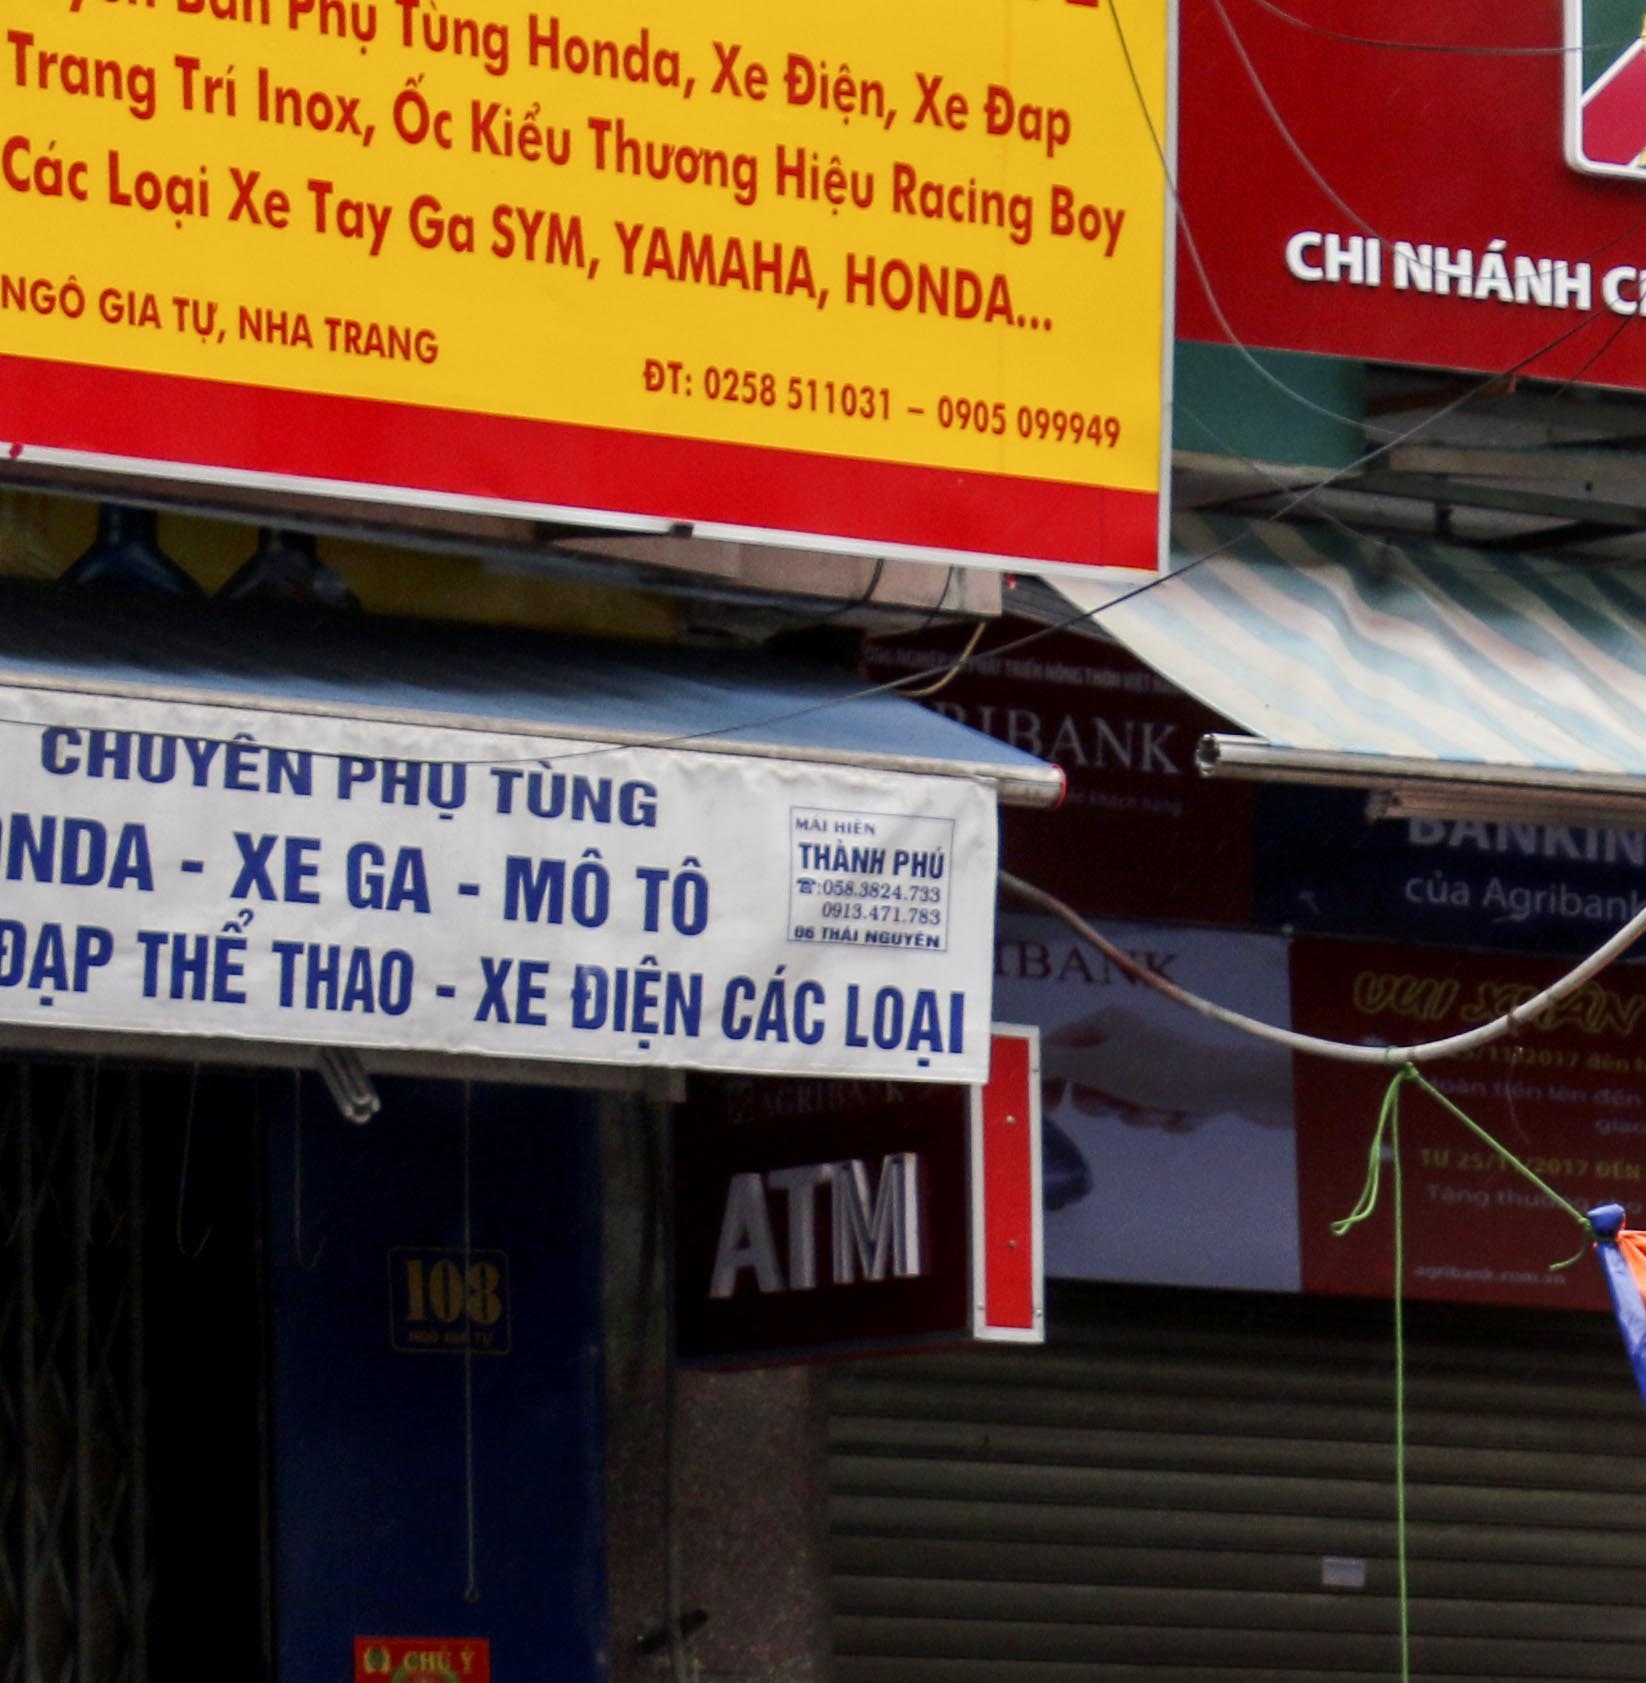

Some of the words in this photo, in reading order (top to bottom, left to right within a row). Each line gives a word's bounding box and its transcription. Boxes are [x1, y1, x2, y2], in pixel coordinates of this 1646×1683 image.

[529, 13, 696, 99] Honda,
[712, 40, 769, 101] Xe
[783, 53, 898, 131] Điện,
[913, 71, 970, 131] Xe
[7, 29, 157, 121] Trang
[174, 55, 237, 118] Trí
[258, 67, 377, 148] Inox,
[392, 74, 454, 150] Ốc
[471, 98, 572, 167] Kiểu
[588, 115, 759, 207] Thương
[775, 143, 875, 217] Hiệu
[892, 161, 1034, 246] Racing
[1050, 183, 1127, 258] Boy
[2, 135, 90, 202] Các
[108, 148, 210, 230] Loại
[228, 166, 291, 229] Xe
[307, 178, 393, 258] Tay
[409, 194, 475, 254] Ga
[490, 202, 601, 281] SYM,
[615, 219, 829, 311] YAMAHA,
[1285, 230, 1383, 288] CHI
[1393, 238, 1592, 313] NHÁNH
[98, 286, 162, 330] GIA
[239, 305, 314, 350] NHA
[324, 316, 440, 366] TRANG
[643, 357, 694, 398] ĐT:
[704, 366, 777, 408] 0258
[787, 375, 893, 422] 511031
[937, 395, 1007, 438] 0905
[1017, 404, 1122, 450] 099949
[40, 726, 314, 797] CHUYÊN
[336, 753, 467, 821] PHỤ
[490, 758, 658, 828] TÙNG
[0, 812, 155, 893] NDA
[229, 830, 323, 906] XE
[346, 840, 432, 915] GA
[503, 846, 611, 929] MÔ
[635, 855, 710, 937] TÔ
[798, 838, 887, 875] THÀNH
[892, 845, 945, 880] PHÚ
[821, 901, 942, 926] 0913.471.783
[136, 907, 256, 1005] THỂ
[271, 939, 415, 1017] THAO
[474, 955, 551, 1028] XE
[569, 954, 704, 1050] ĐIỆN
[720, 963, 826, 1047] CÁC
[845, 983, 966, 1068] LOẠI
[706, 1150, 922, 1302] ATM
[405, 1258, 504, 1327] 108
